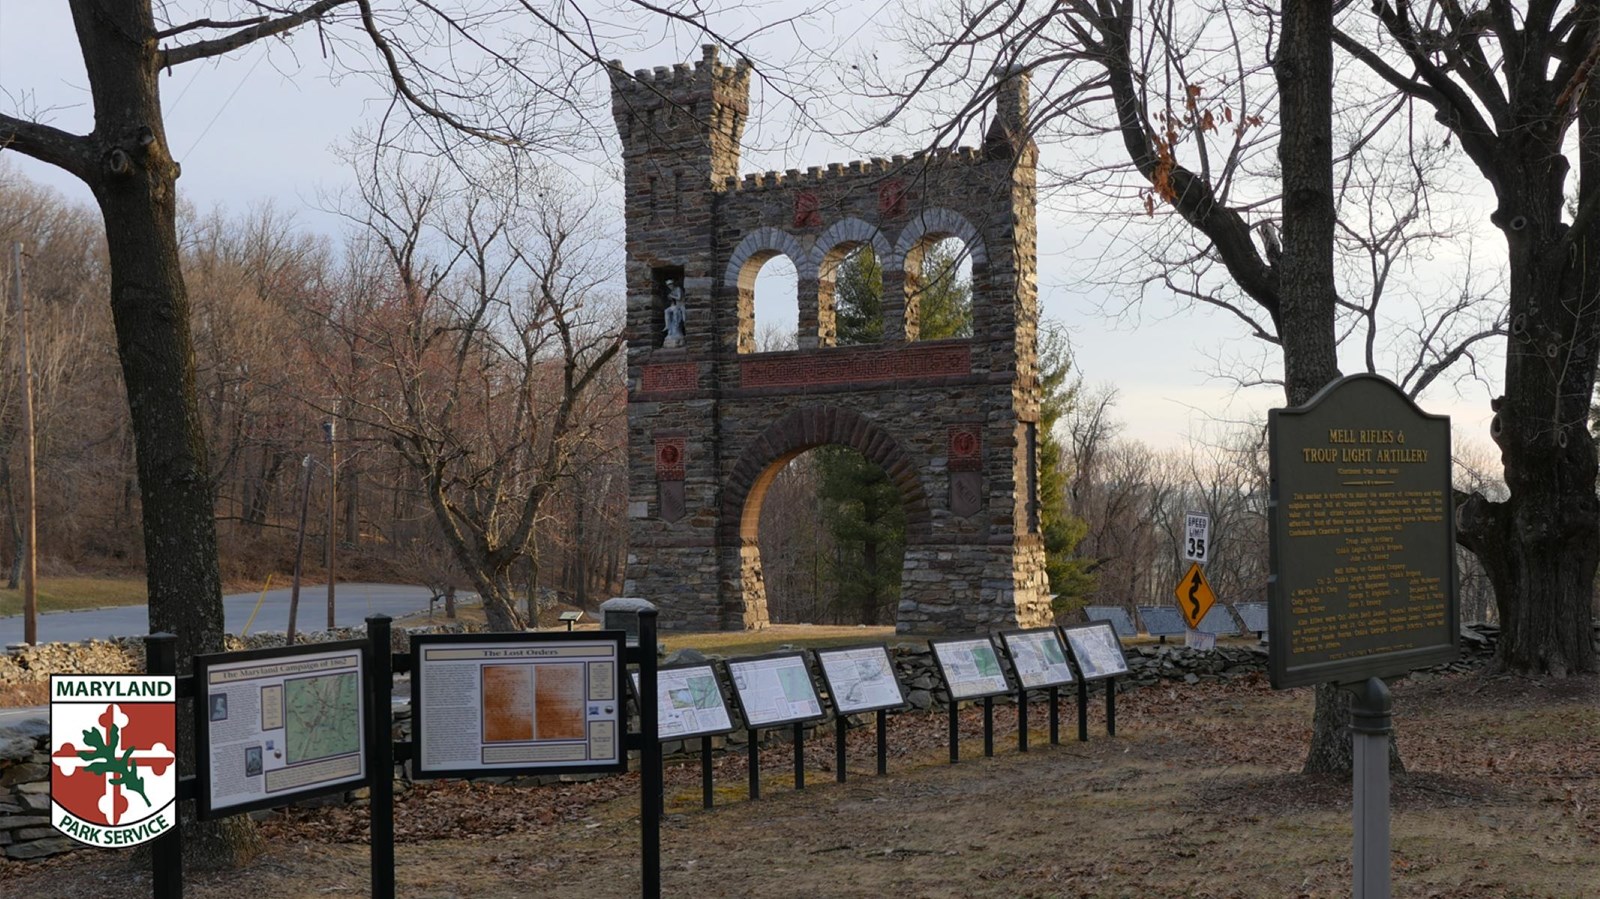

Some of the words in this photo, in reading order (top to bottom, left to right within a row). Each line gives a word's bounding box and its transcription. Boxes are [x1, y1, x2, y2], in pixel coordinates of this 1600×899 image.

[1329, 429, 1356, 443] MELL
[1360, 430, 1394, 443] RIFLES
[1303, 448, 1338, 462] TROUP
[1343, 448, 1372, 462] LIGHT
[1377, 449, 1428, 462] ARTILLERY
[1188, 517, 1207, 528] SPEED
[1189, 528, 1205, 538] LIMIT
[1187, 538, 1205, 559] 35
[223, 671, 239, 679] The
[240, 666, 278, 677] Maryland
[280, 661, 319, 672] Campaign
[320, 660, 328, 668] of
[330, 659, 347, 667] 1862
